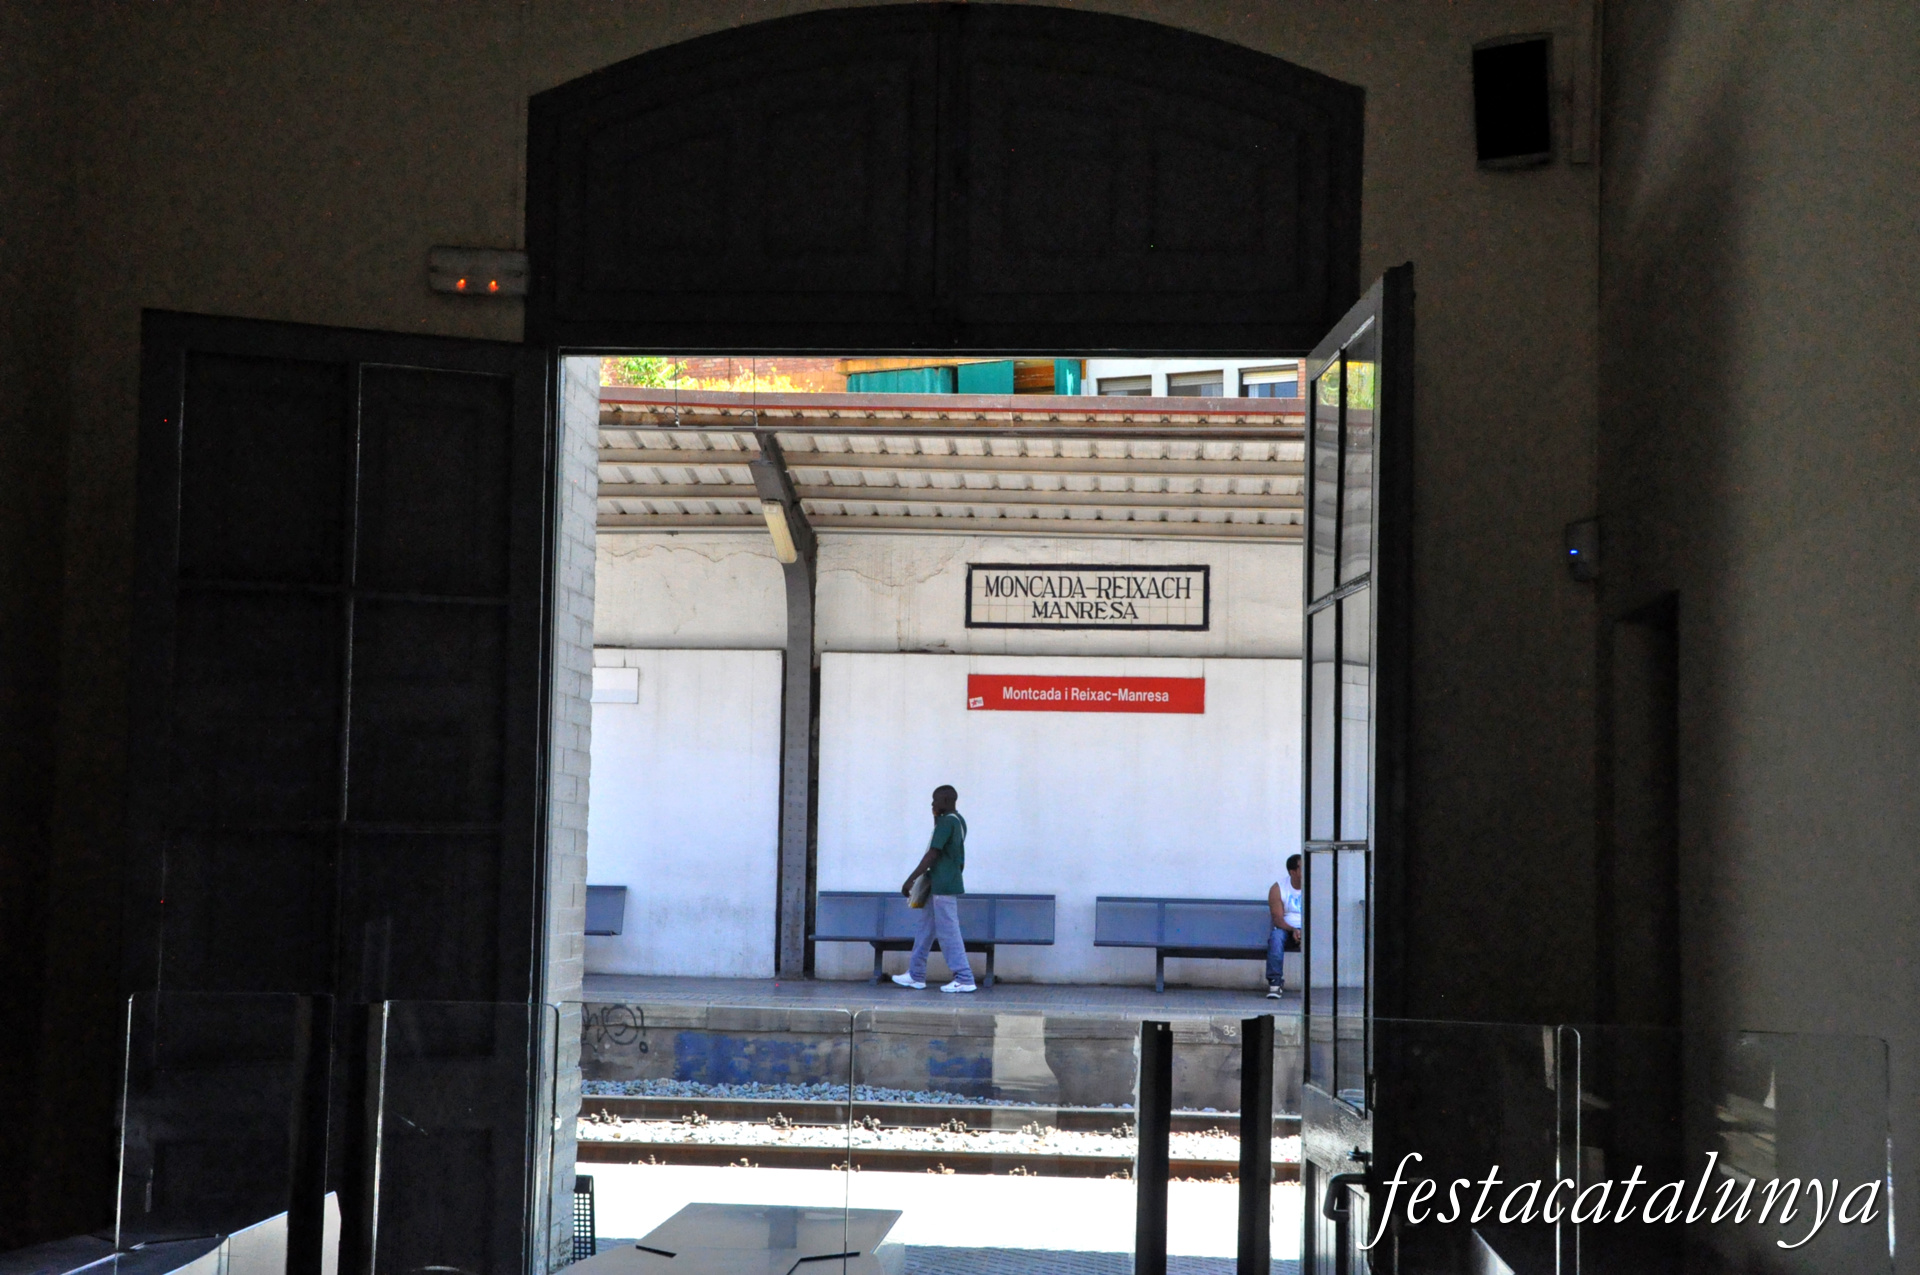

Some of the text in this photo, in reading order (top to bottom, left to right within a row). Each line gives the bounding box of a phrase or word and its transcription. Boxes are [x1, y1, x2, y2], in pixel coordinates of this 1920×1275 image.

[984, 575, 1192, 600] MONCADA-REIXACH
[1031, 601, 1139, 620] MANRESA
[1002, 686, 1169, 702] Montcada i Reixac-Manresa
